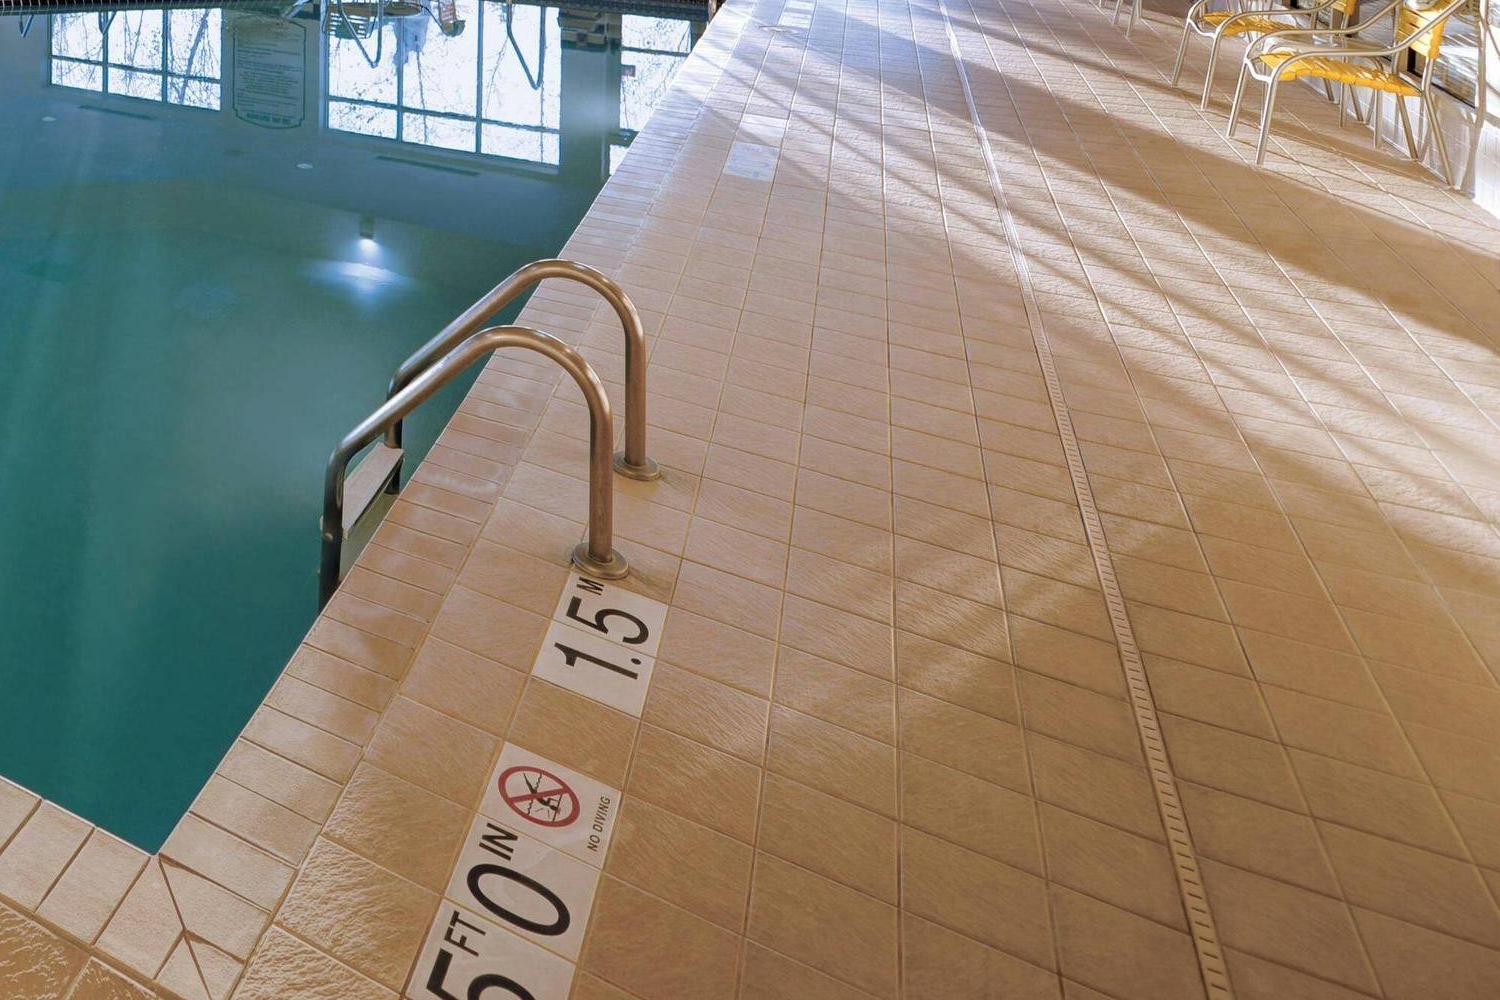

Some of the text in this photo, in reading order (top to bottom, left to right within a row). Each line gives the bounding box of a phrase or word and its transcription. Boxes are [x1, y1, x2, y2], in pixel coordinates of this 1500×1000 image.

[576, 576, 605, 596] M
[479, 822, 519, 862] IN
[586, 796, 611, 852] NO DIVING
[466, 863, 571, 936] 0
[444, 910, 487, 957] FT
